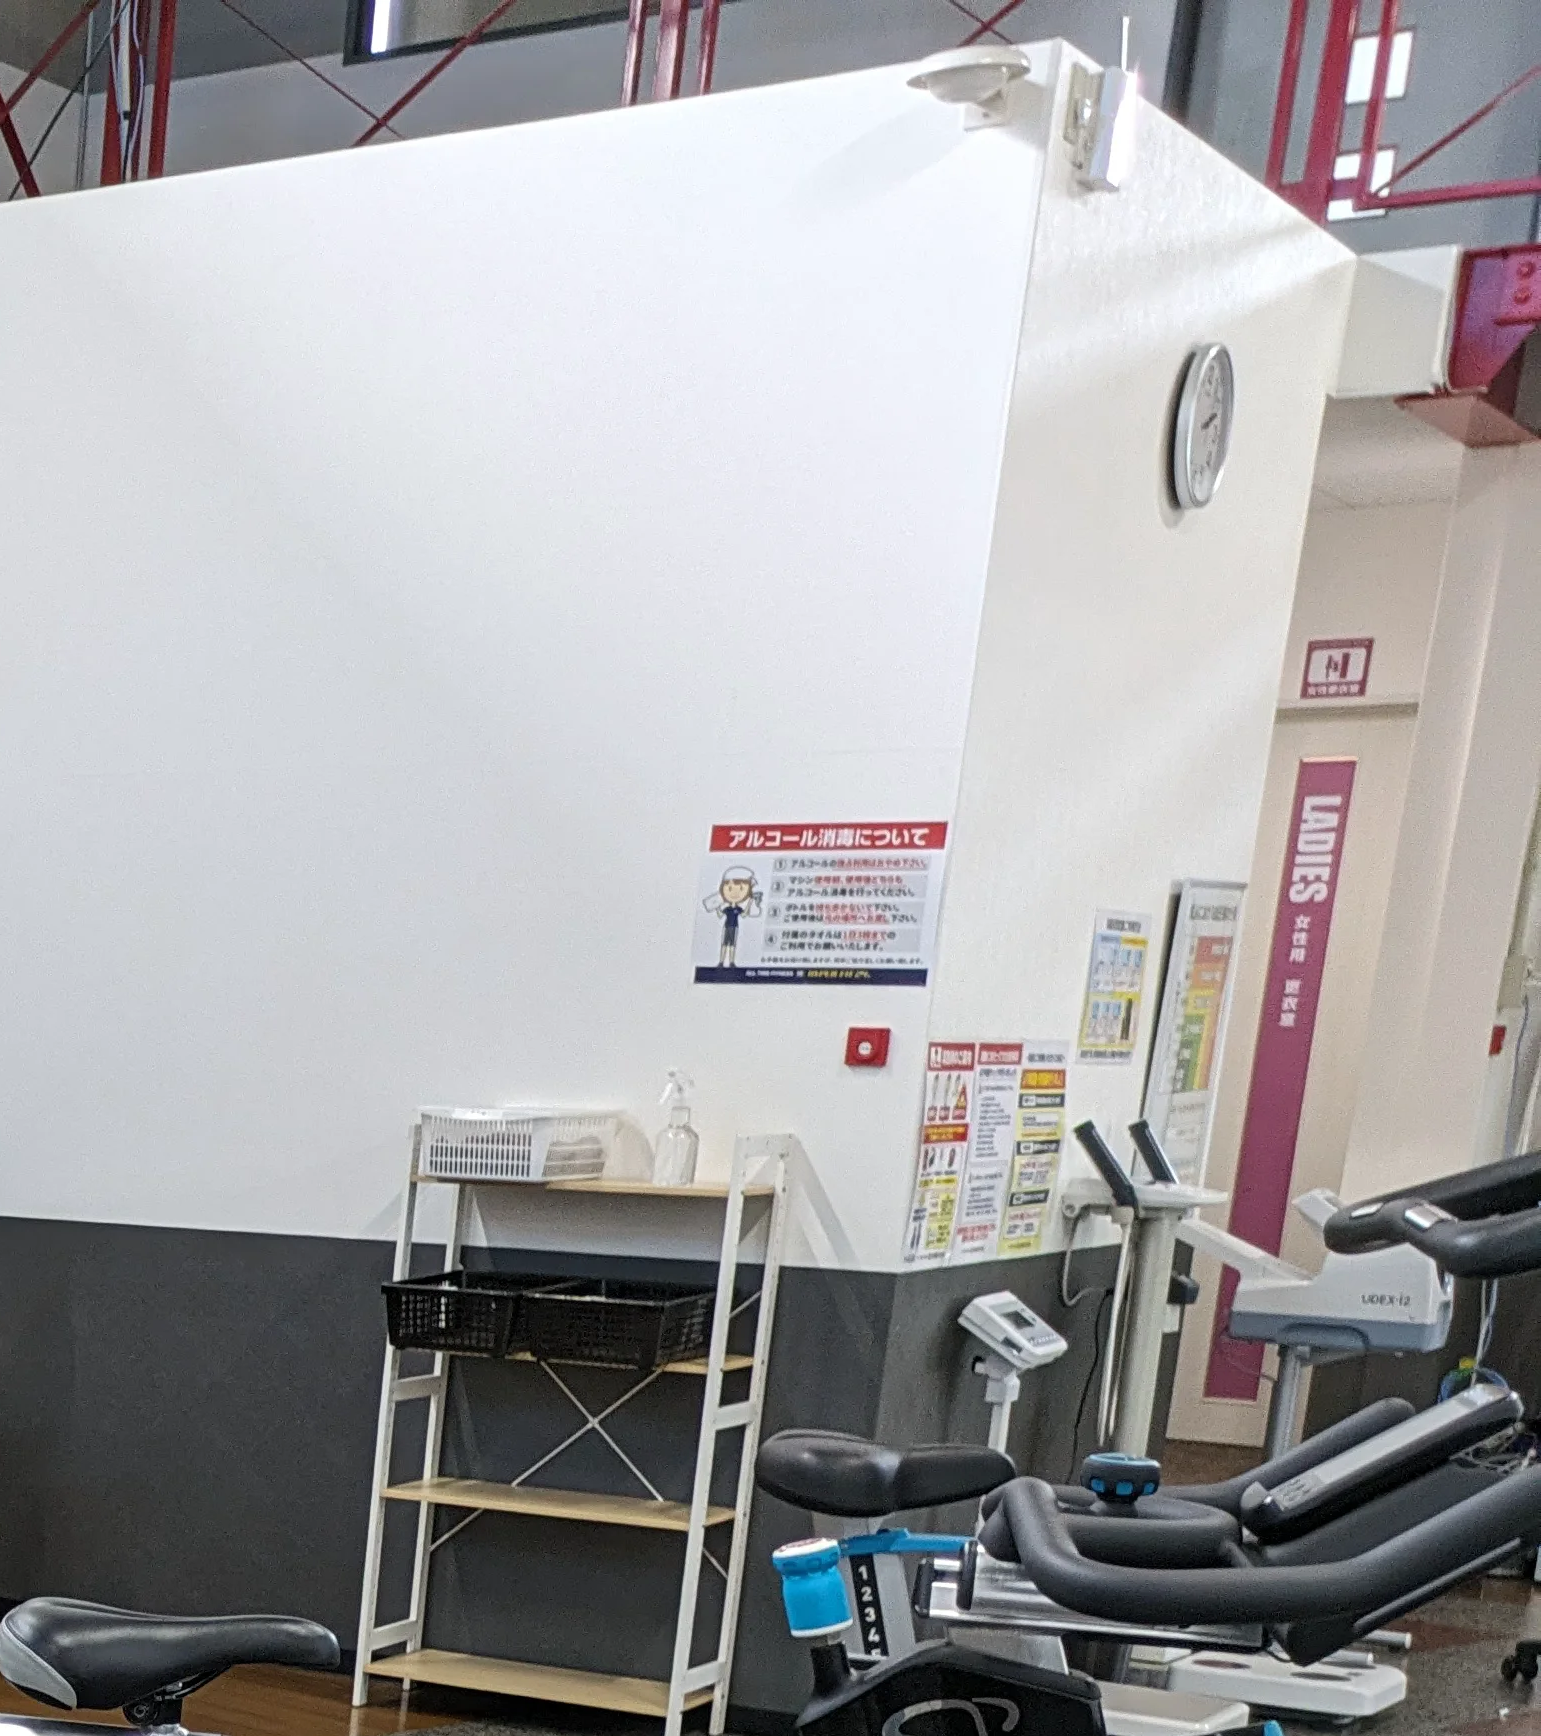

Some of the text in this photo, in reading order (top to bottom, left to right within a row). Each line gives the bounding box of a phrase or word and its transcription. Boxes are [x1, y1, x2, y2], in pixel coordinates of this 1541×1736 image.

[728, 827, 930, 848] アルコール消毒について
[1289, 795, 1342, 904] LADIES
[858, 1564, 868, 1580] 1
[861, 1586, 873, 1601] 2
[864, 1607, 876, 1622] 3
[868, 1627, 880, 1643] 4
